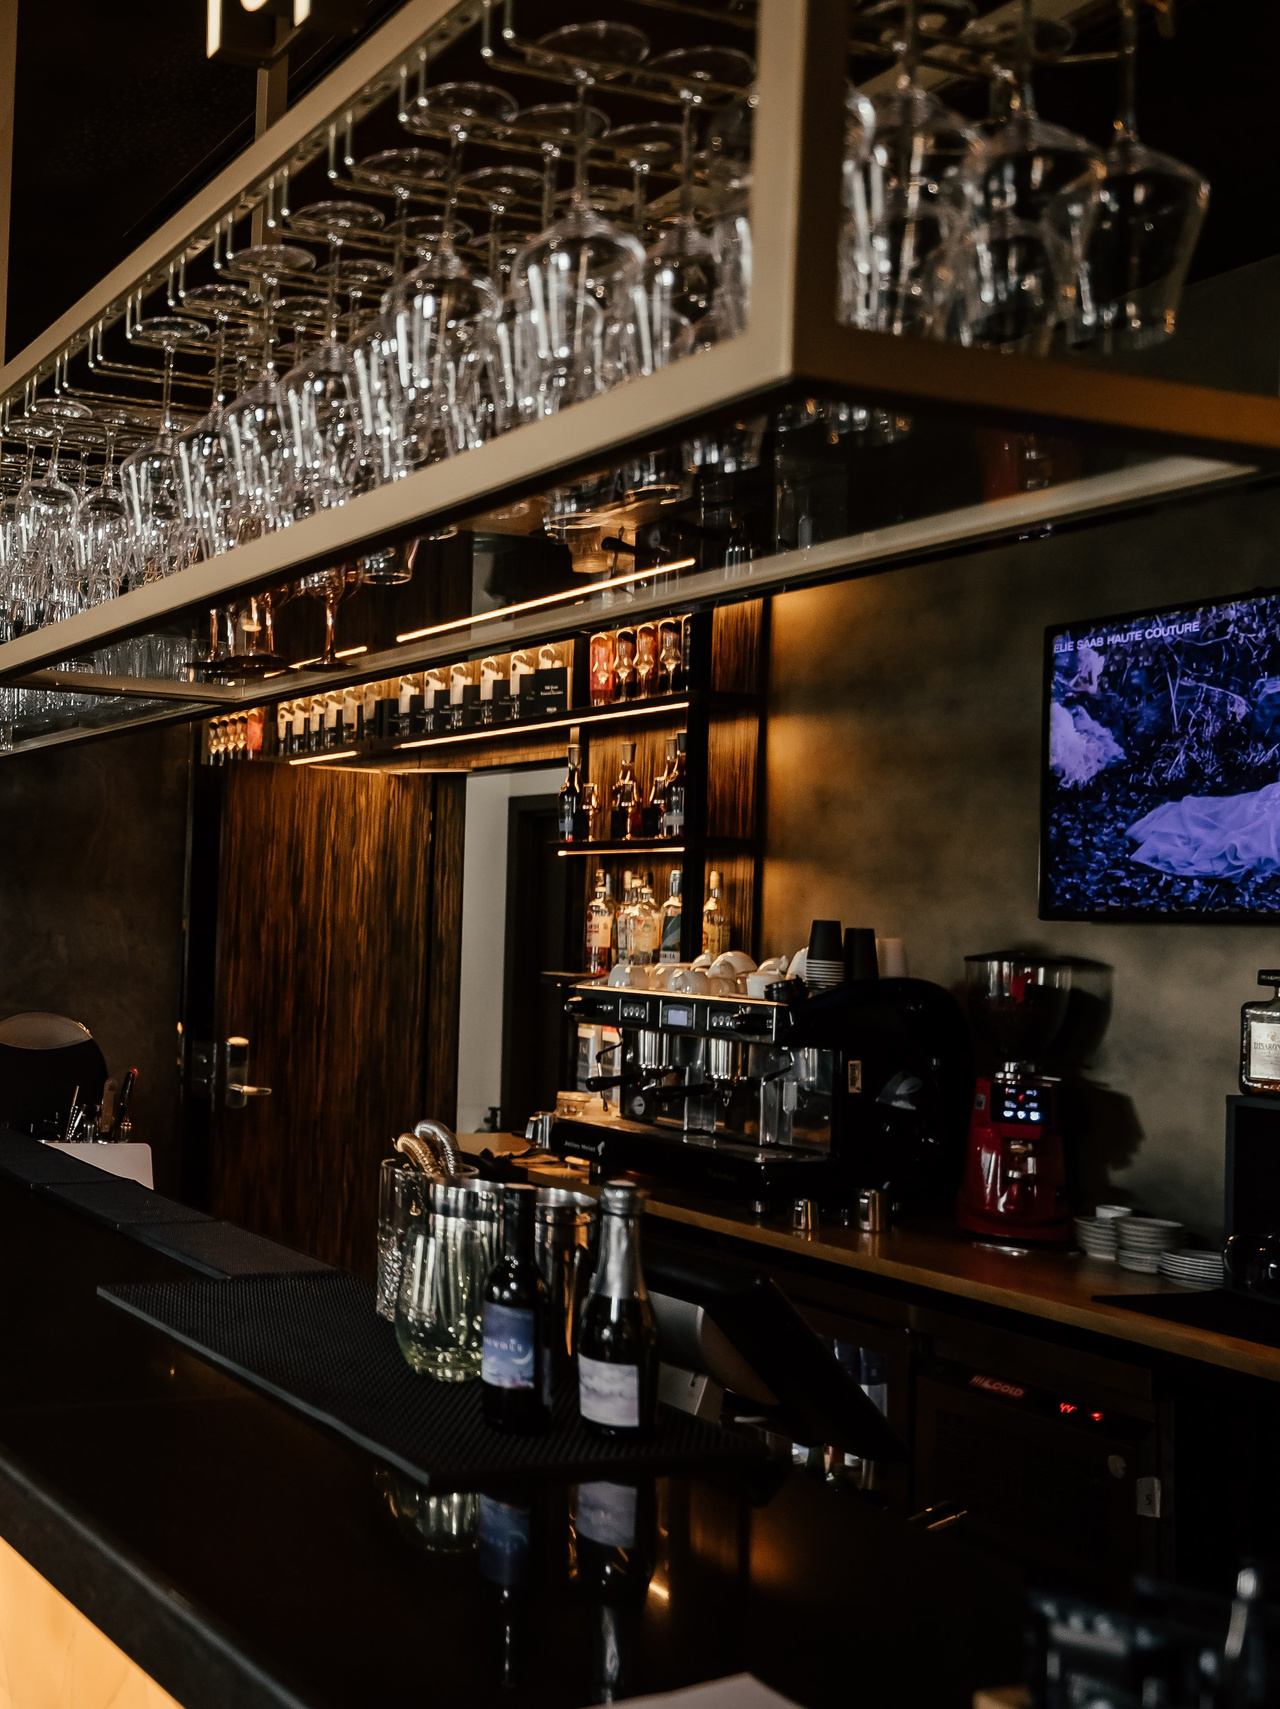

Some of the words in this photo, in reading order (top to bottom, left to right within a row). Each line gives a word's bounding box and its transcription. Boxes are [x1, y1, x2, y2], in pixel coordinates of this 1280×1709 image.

[1053, 641, 1075, 653] ELIE
[1076, 637, 1104, 650] SAAB
[1107, 630, 1142, 645] HAUTE
[1145, 621, 1200, 639] COUTURE
